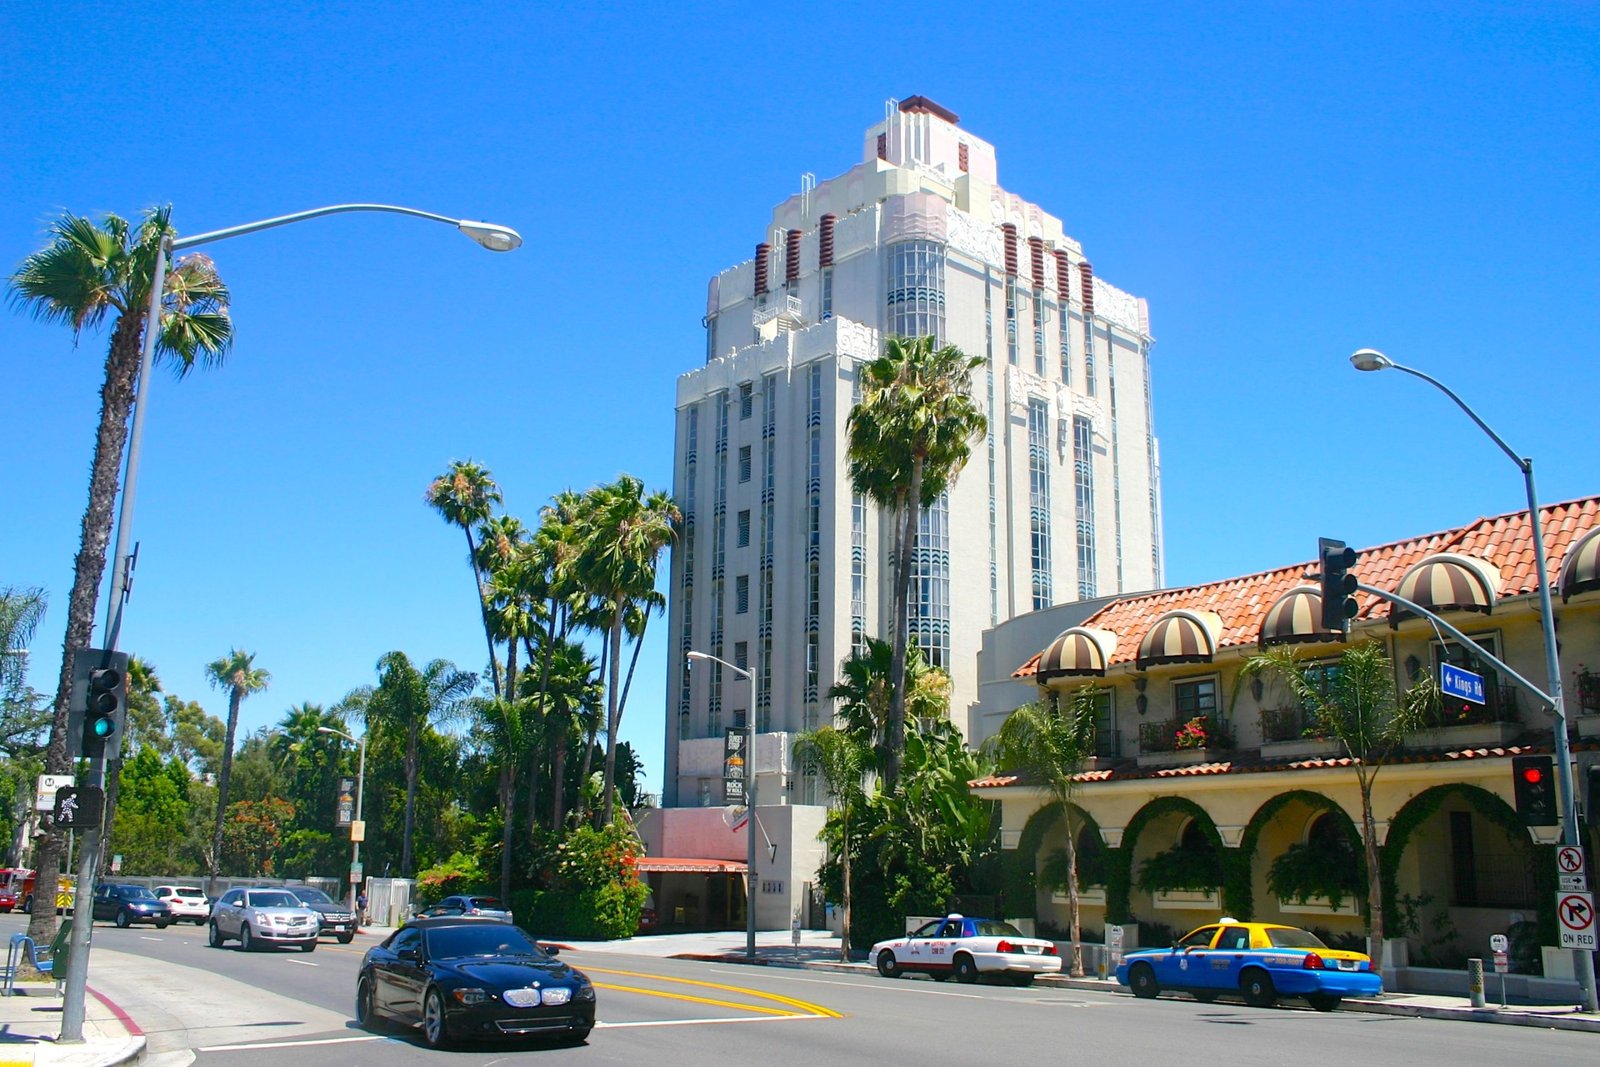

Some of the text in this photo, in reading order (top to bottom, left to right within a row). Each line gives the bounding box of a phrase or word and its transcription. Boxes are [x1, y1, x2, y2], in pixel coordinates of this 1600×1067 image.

[1454, 674, 1483, 697] Kings Rd
[729, 735, 743, 744] SUNSET
[1562, 933, 1594, 945] ON RED
